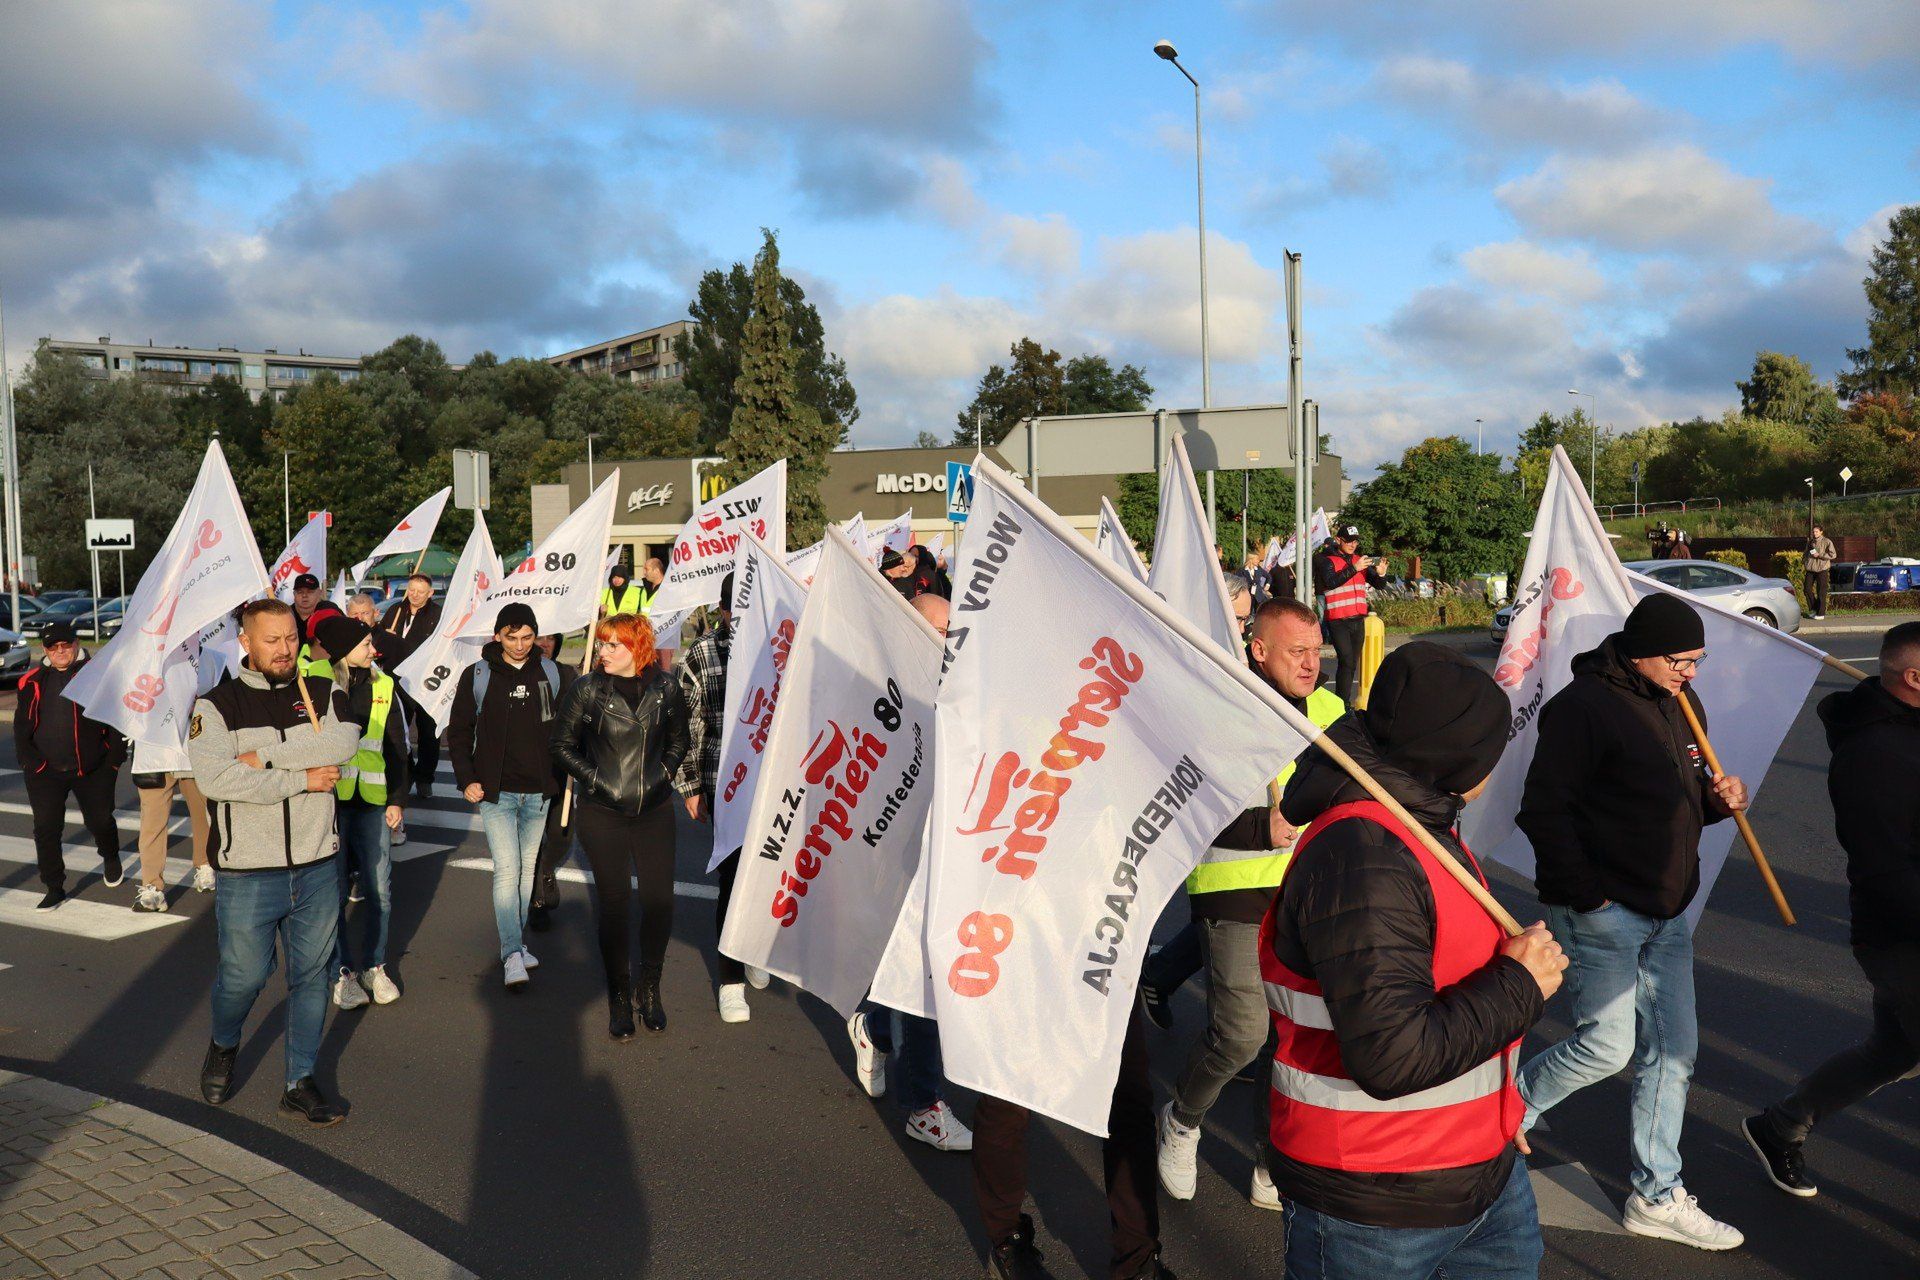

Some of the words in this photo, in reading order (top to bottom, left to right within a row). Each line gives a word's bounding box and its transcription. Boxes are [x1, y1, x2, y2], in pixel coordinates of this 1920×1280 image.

[544, 552, 577, 573] 80
[771, 724, 888, 928] Sierpień
[873, 677, 904, 733] 80
[862, 720, 923, 849] Konfederacja
